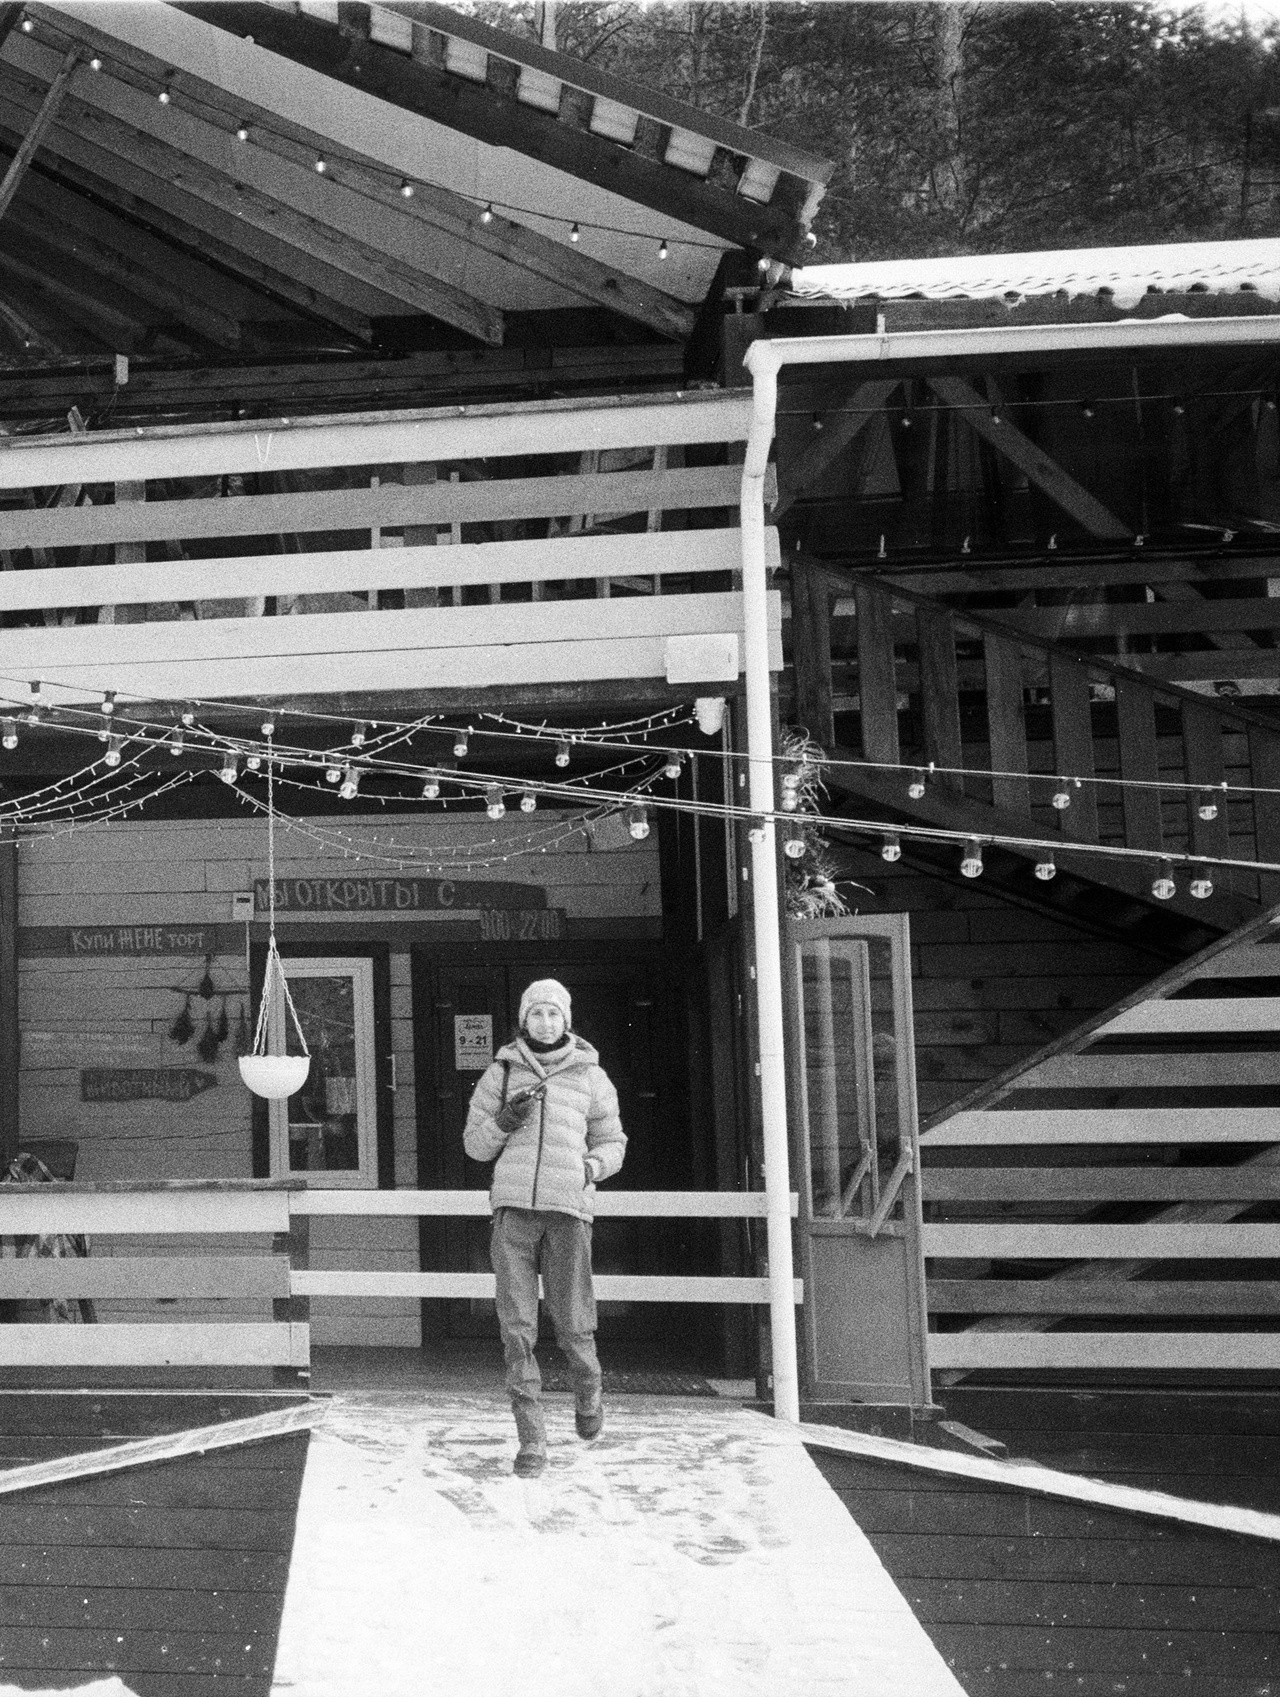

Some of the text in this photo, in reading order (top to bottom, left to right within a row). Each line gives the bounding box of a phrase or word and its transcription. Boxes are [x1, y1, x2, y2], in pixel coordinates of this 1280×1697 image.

[295, 879, 419, 908] ОТКРЫТЫ
[119, 926, 163, 950] ЖЕНЕ
[475, 1035, 487, 1045] 21
